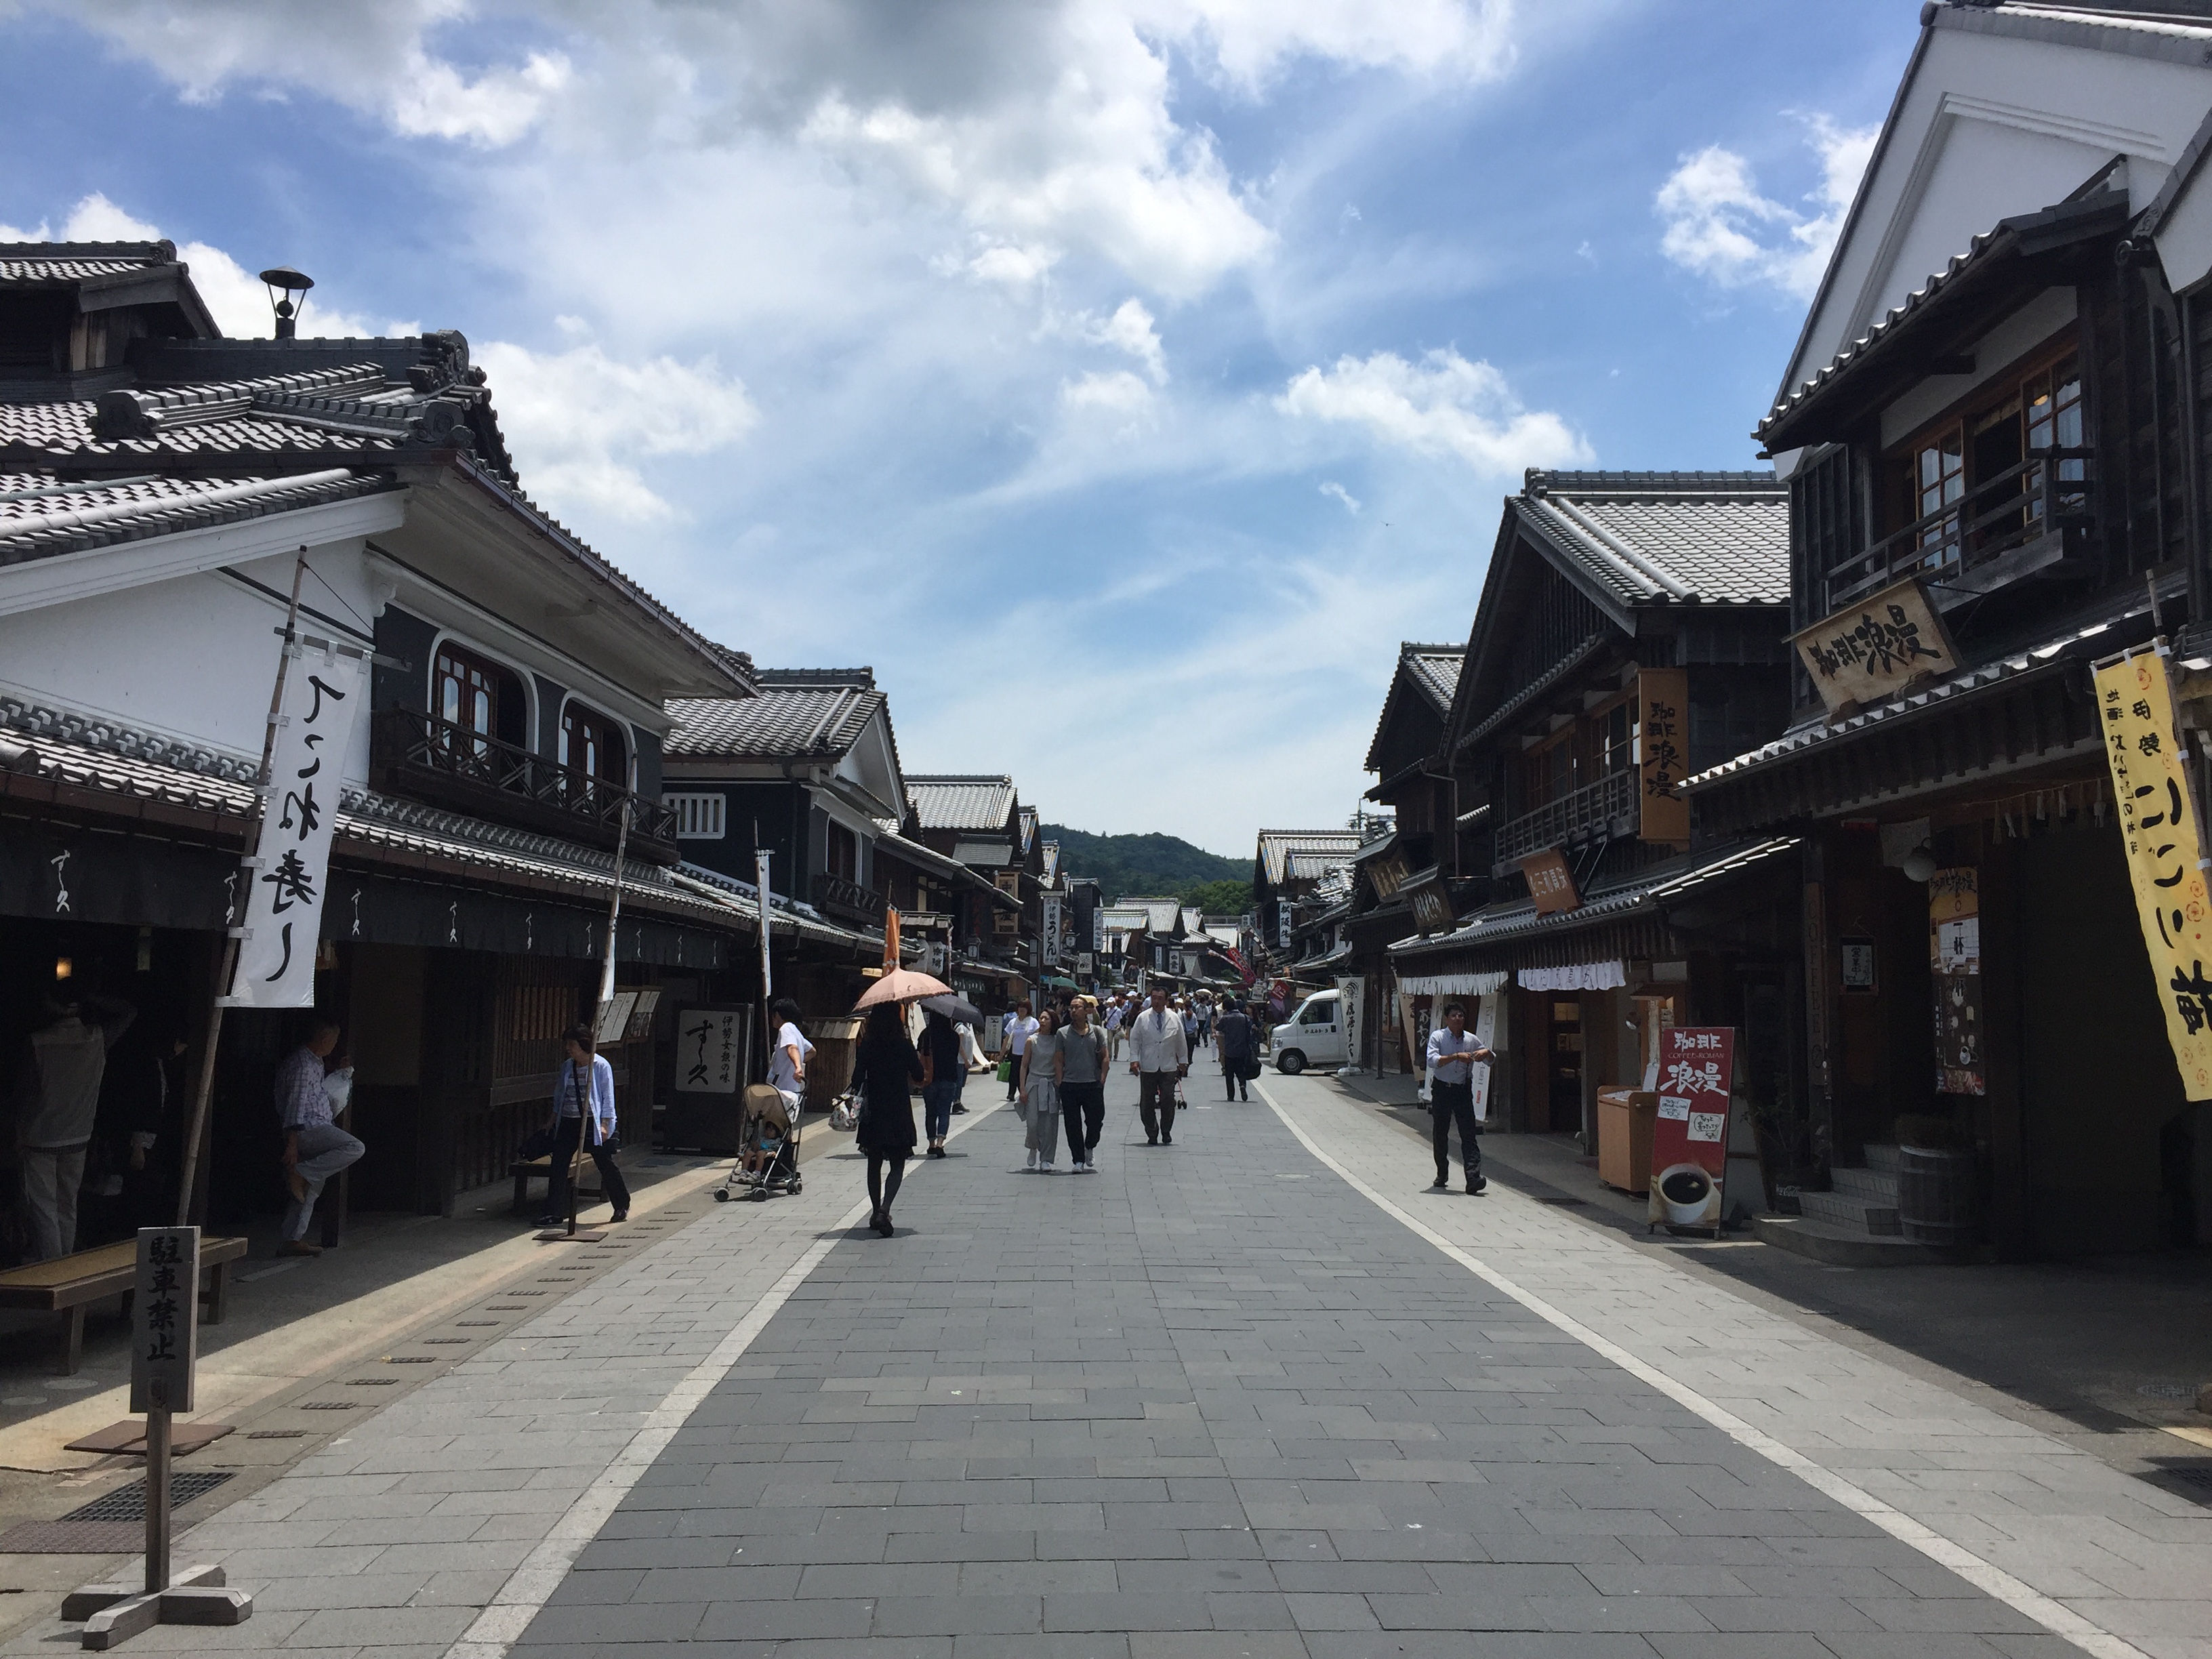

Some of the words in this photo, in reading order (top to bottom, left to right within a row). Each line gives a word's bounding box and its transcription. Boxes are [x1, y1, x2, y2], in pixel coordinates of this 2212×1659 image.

[1807, 605, 1942, 679] 珈琲浪漫
[1643, 701, 1683, 802] 珈琲浪漫
[1280, 904, 1291, 938] 松阪牛
[1674, 1030, 1723, 1053] 珈琲
[1660, 1061, 1728, 1097] 浪漫
[146, 1235, 183, 1361] 駐車禁止
